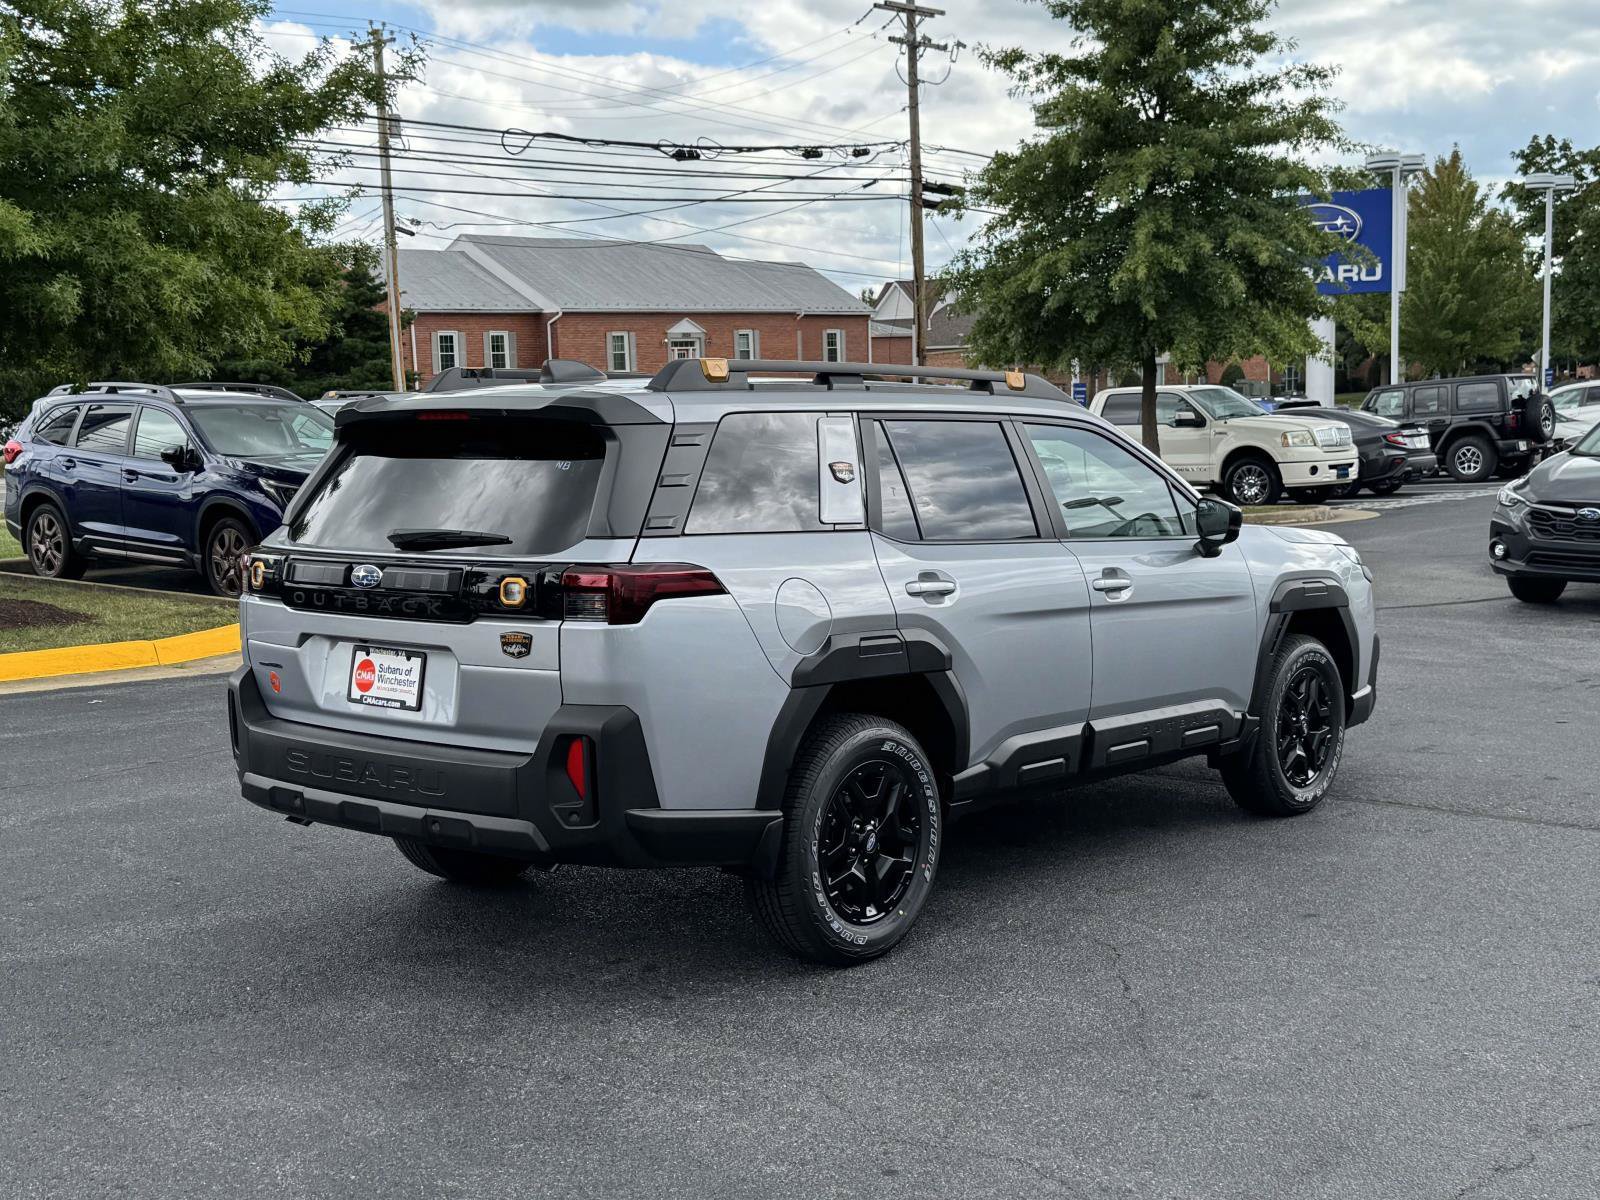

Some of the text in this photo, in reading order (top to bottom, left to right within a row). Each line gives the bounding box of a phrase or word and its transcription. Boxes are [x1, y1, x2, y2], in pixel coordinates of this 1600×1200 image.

[293, 591, 442, 615] OUTBACK
[379, 663, 413, 676] Subaru of
[377, 674, 417, 688] Winchester
[362, 695, 401, 708] CMAcars.com
[287, 750, 447, 796] SUBARU
[881, 741, 938, 882] BRIDGESTONE
